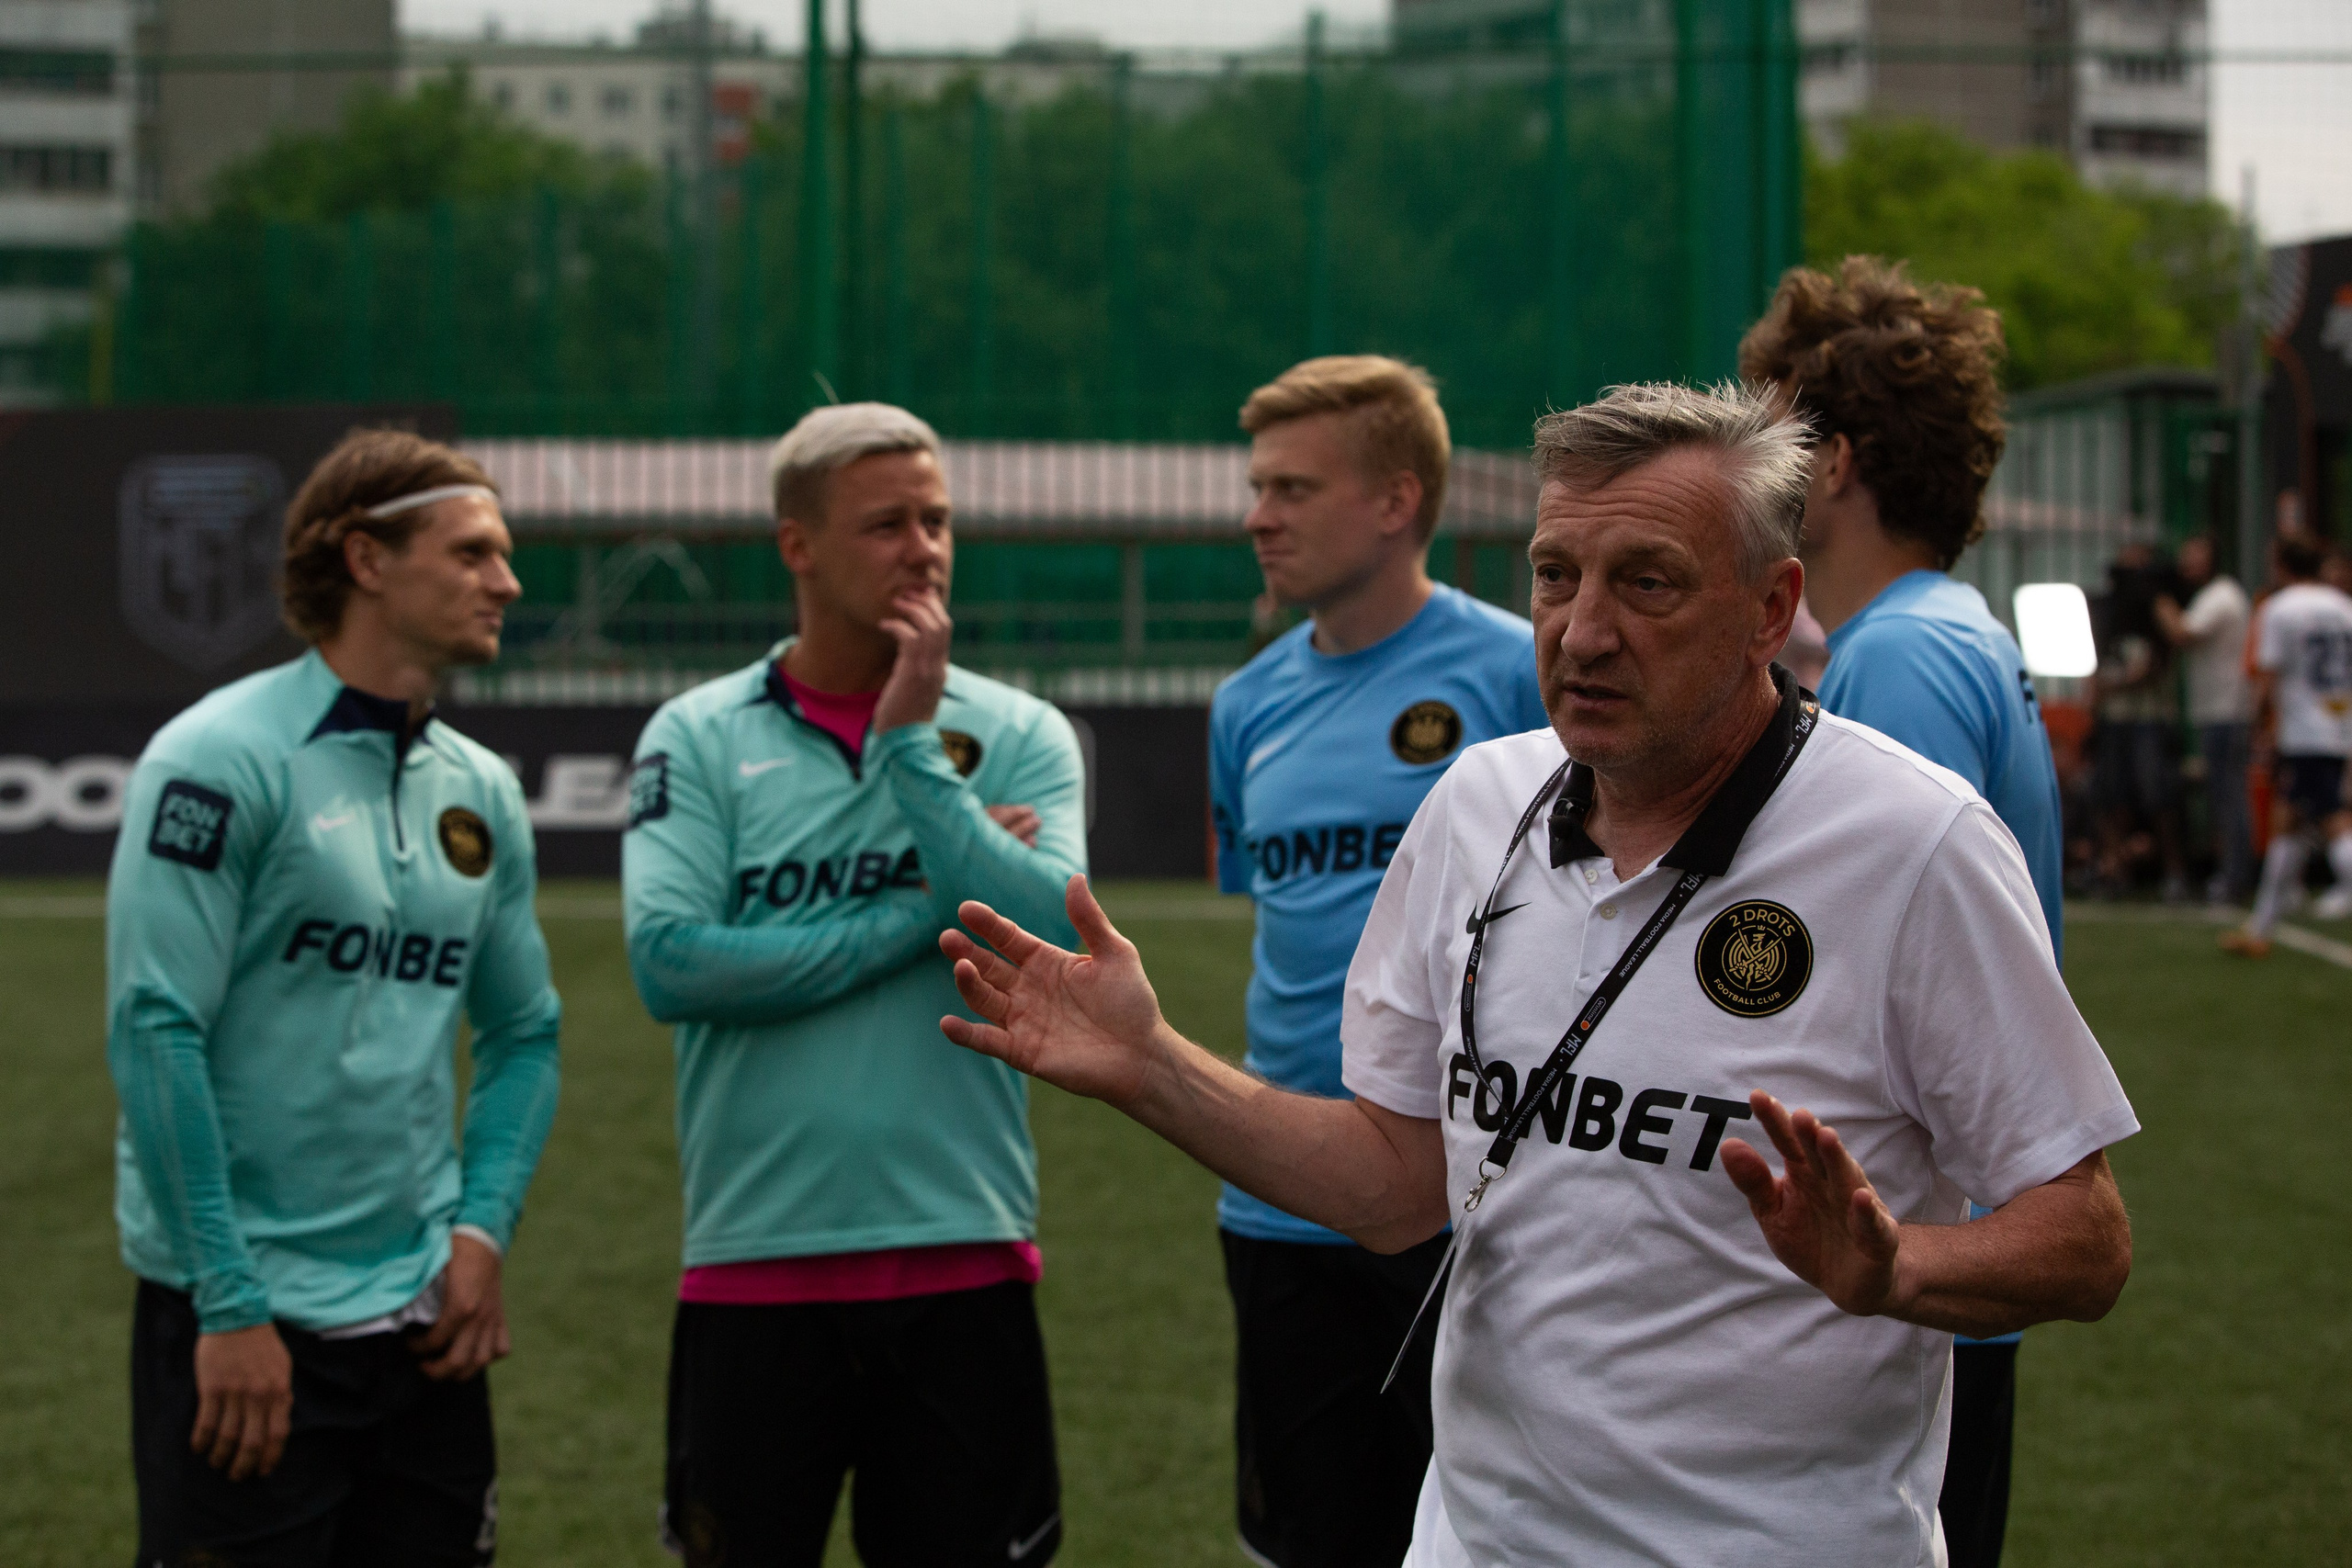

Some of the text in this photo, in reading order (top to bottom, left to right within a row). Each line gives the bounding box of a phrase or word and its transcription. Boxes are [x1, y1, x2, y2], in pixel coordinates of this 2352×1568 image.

[1794, 713, 1813, 734] MFL
[1515, 818, 1528, 838] MEDIA
[1526, 788, 1548, 818] FOOTBALL
[1248, 824, 1408, 882] ONBE
[735, 845, 920, 914] FONBE
[1680, 873, 1704, 891] MFL
[1619, 903, 1677, 978] MEDIA FOOTBALL LEAGUE
[1729, 908, 1796, 937] 2 DROTS
[283, 919, 468, 987] FONBE
[1470, 943, 1481, 967] MFL
[1587, 1000, 1604, 1021] Winline
[1713, 978, 1781, 1006] FOOTBALL CLUB
[1559, 1032, 1582, 1056] MFL
[1448, 1053, 1753, 1172] FONBET
[1507, 1067, 1557, 1140] MEDIA FOOTBALL LEAGUE
